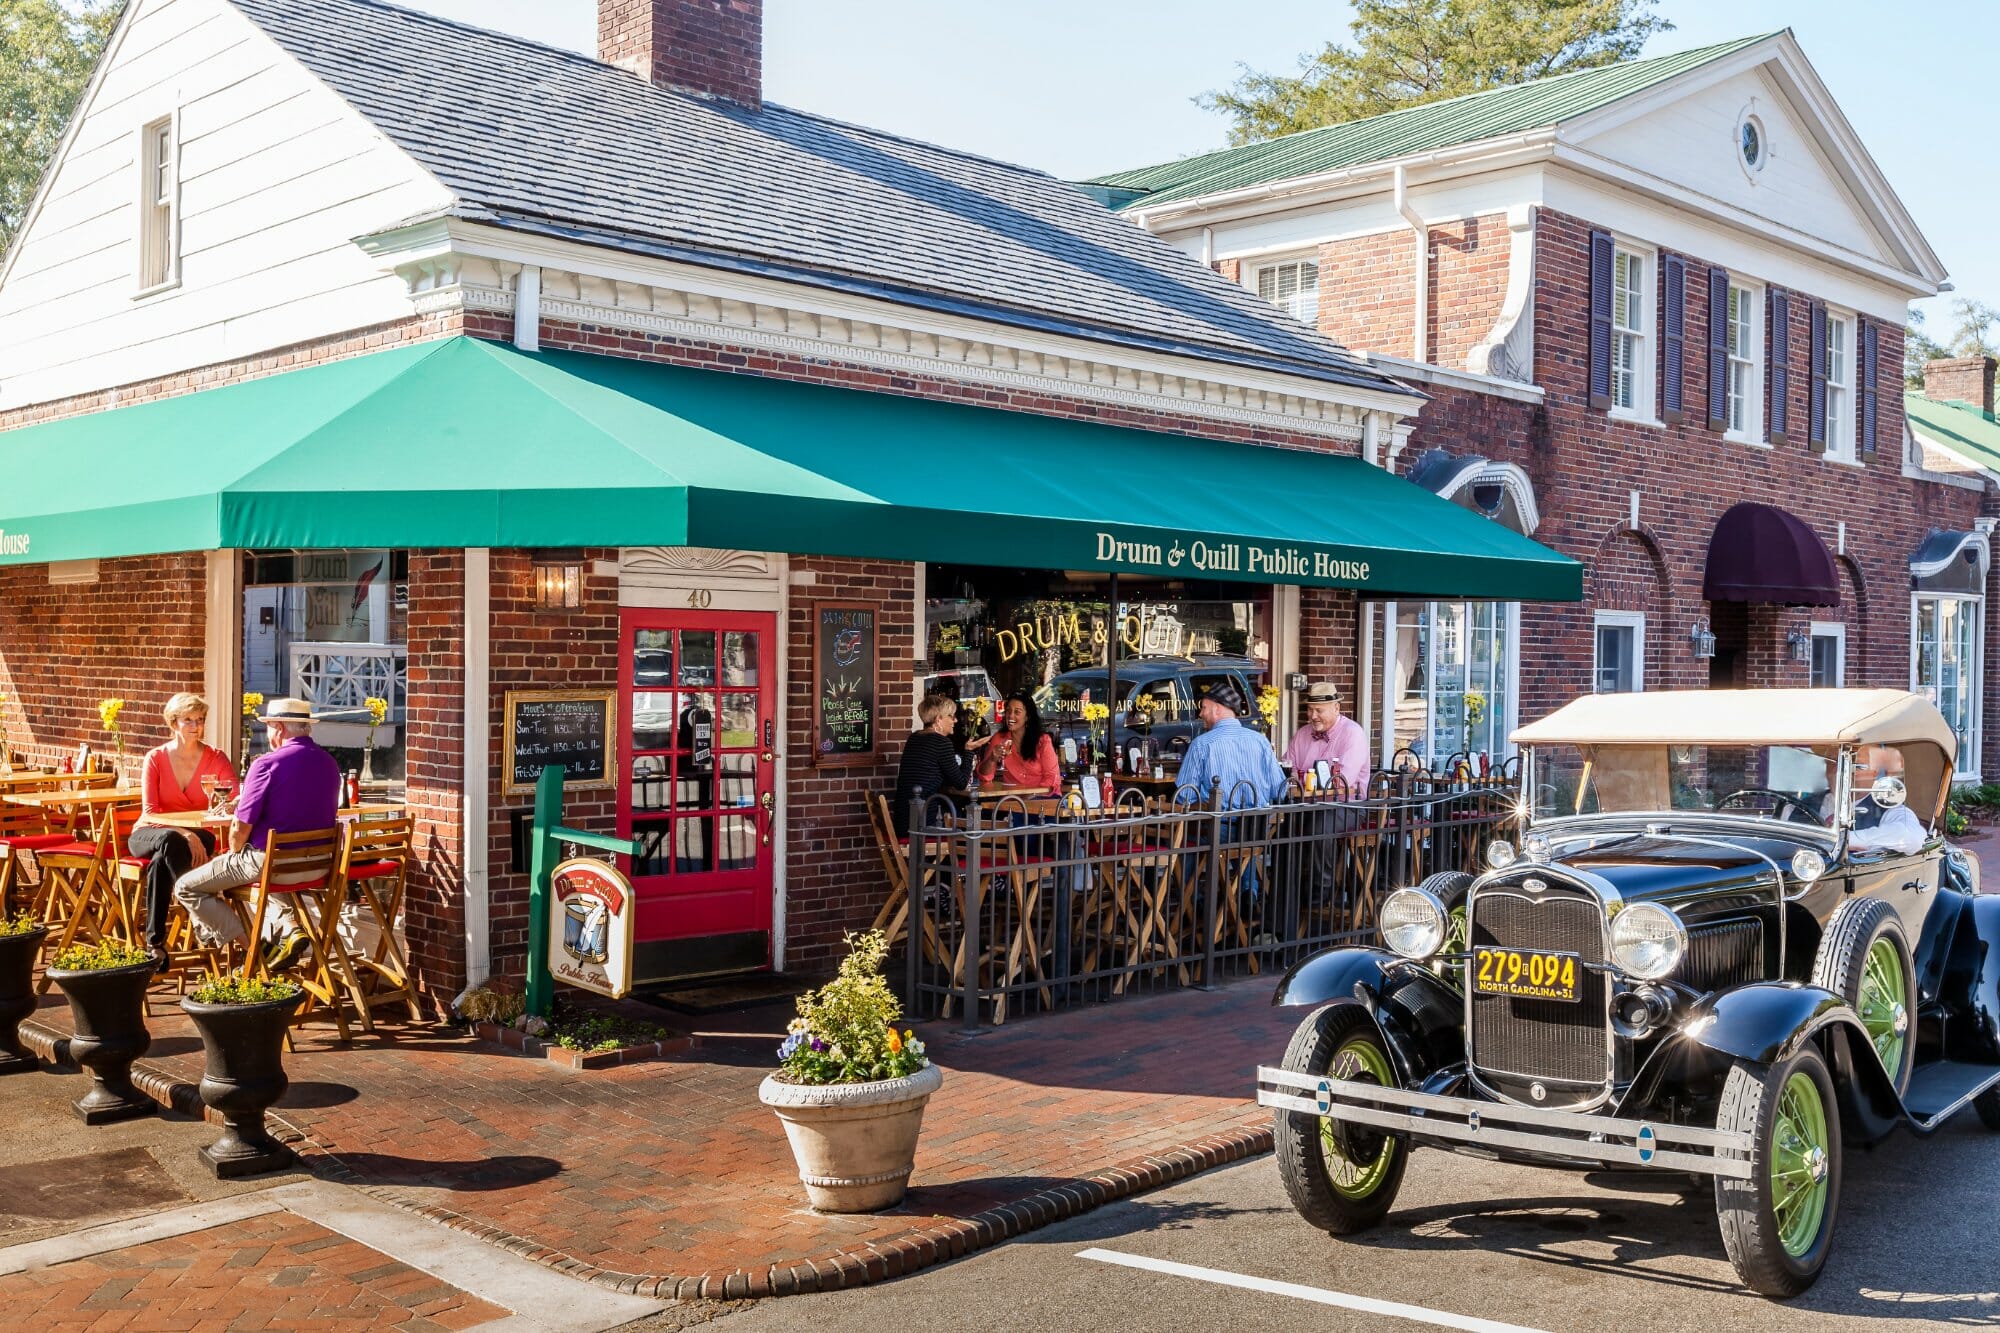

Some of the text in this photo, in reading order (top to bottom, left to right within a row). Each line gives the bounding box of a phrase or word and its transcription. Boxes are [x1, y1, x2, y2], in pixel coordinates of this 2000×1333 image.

[1096, 533, 1370, 580] Drum & Quill Public House
[687, 589, 712, 608] 40
[996, 614, 1196, 663] DRUM & QUILL
[1115, 700, 1133, 712] AIR
[1135, 699, 1202, 712] CDITIONIN
[557, 963, 585, 981] Public
[1479, 950, 1575, 989] 279 094
[1479, 981, 1508, 993] NORTH
